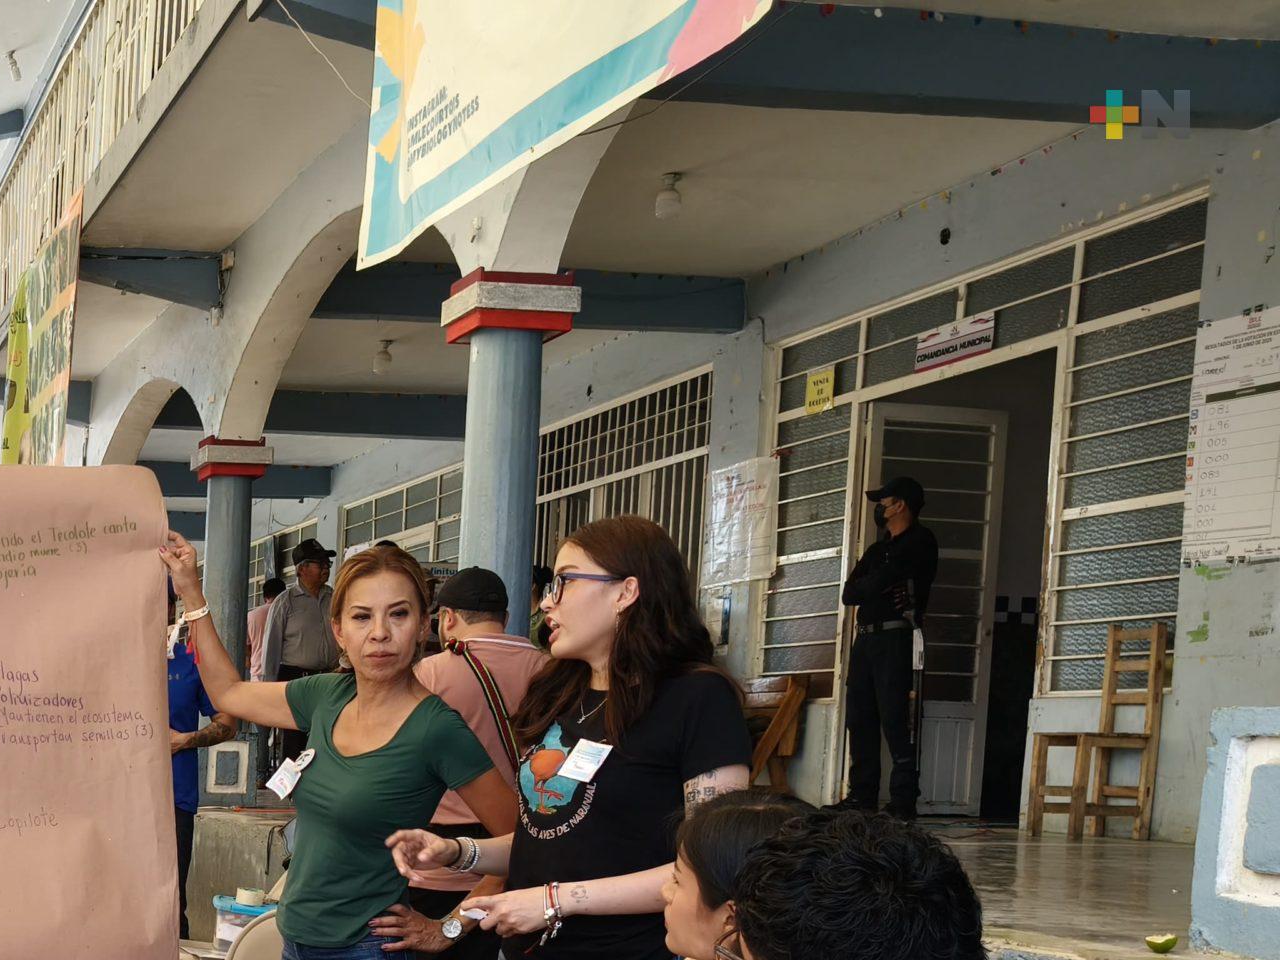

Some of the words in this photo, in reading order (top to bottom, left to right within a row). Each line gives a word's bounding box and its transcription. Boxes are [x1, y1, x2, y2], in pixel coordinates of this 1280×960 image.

[916, 344, 958, 363] COMANDANCIA
[959, 334, 992, 351] MUNICIPAL
[31, 531, 41, 543] el
[104, 517, 136, 534] canta
[82, 703, 143, 724] ecosistema
[80, 722, 130, 742] semillas
[539, 829, 556, 840] AVES
[556, 822, 570, 837] DE
[569, 782, 597, 828] NARANJAL
